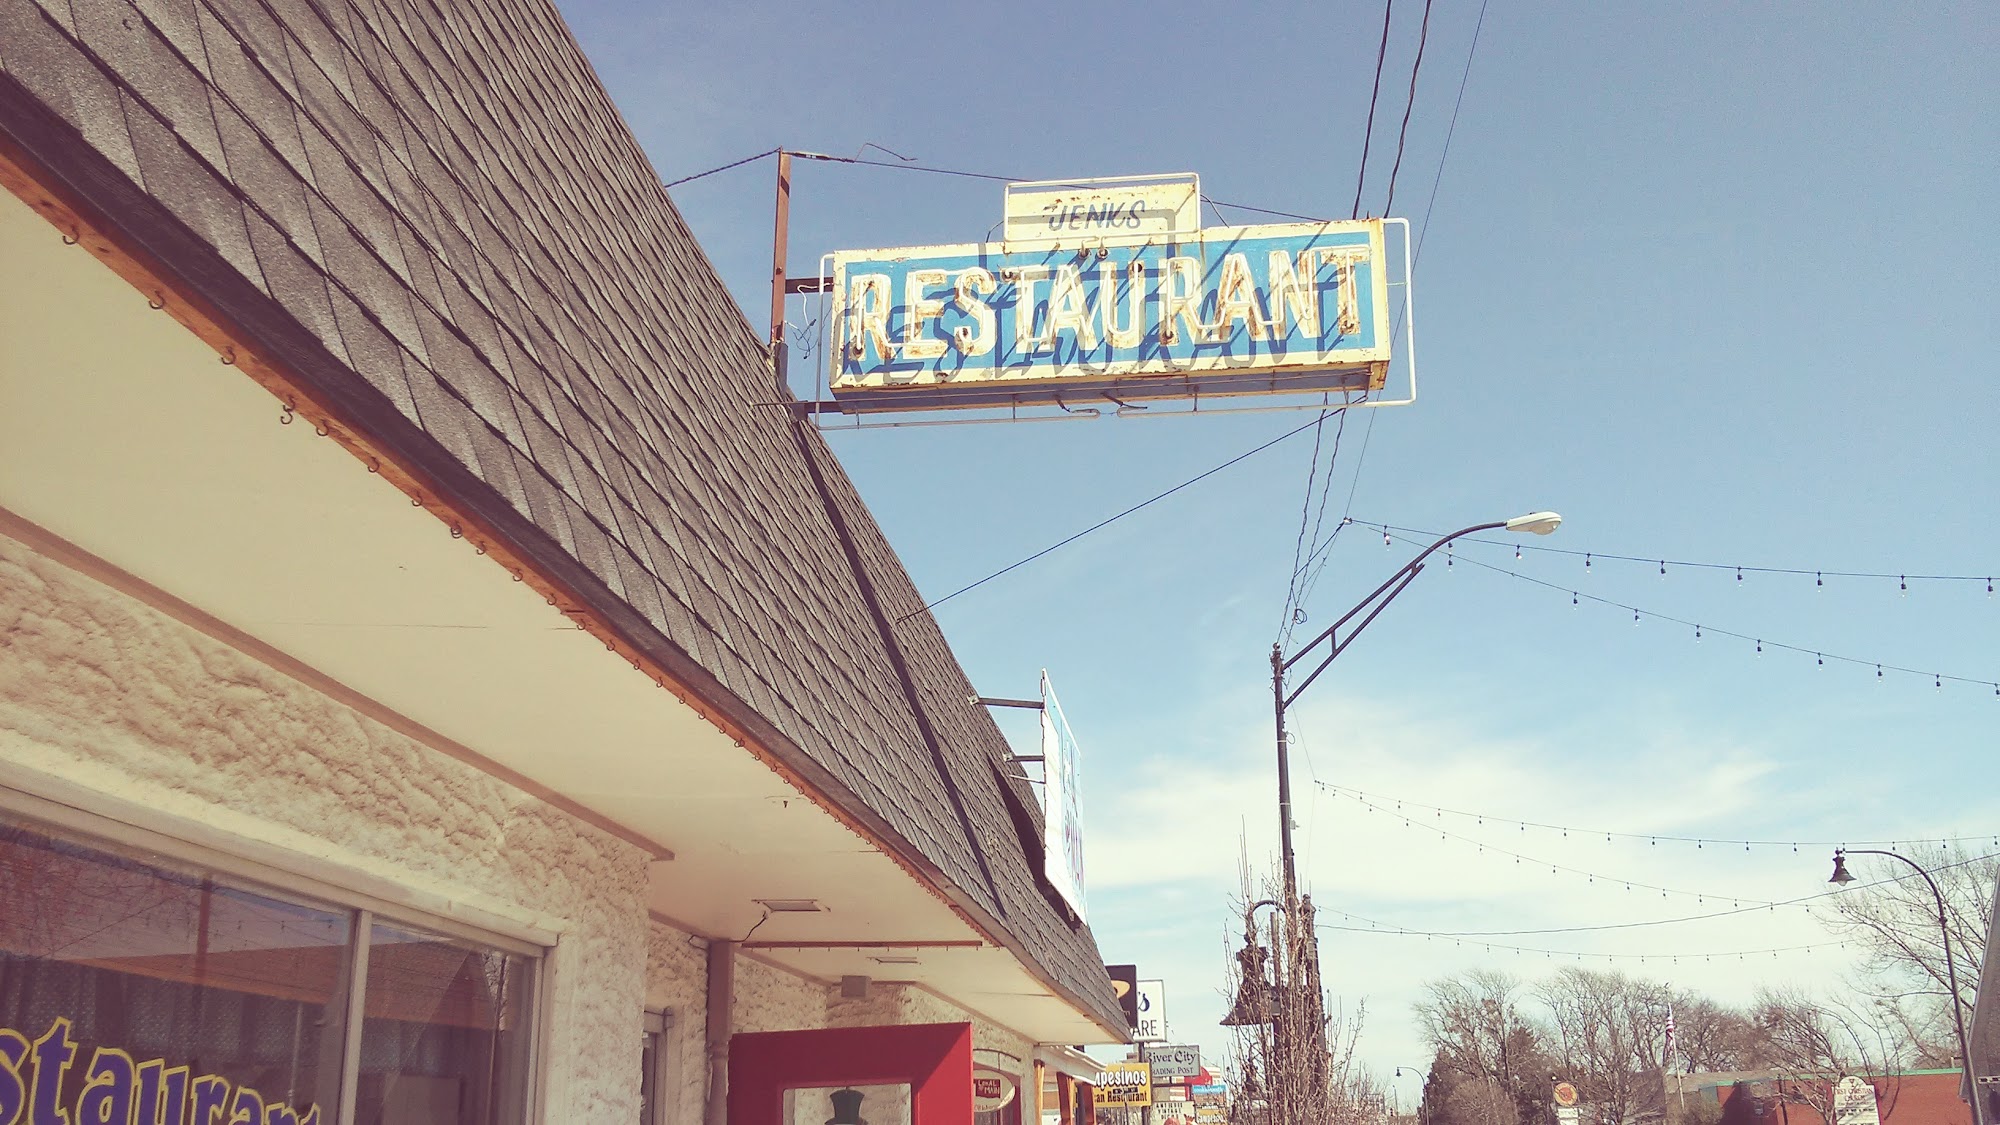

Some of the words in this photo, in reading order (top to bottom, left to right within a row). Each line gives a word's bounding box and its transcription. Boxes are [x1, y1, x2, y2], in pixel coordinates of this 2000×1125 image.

[1048, 200, 1145, 231] JENKS
[846, 246, 1370, 362] RESTAURANT
[1146, 1051, 1172, 1065] River
[1174, 1050, 1196, 1065] City
[1094, 1093, 1105, 1103] an
